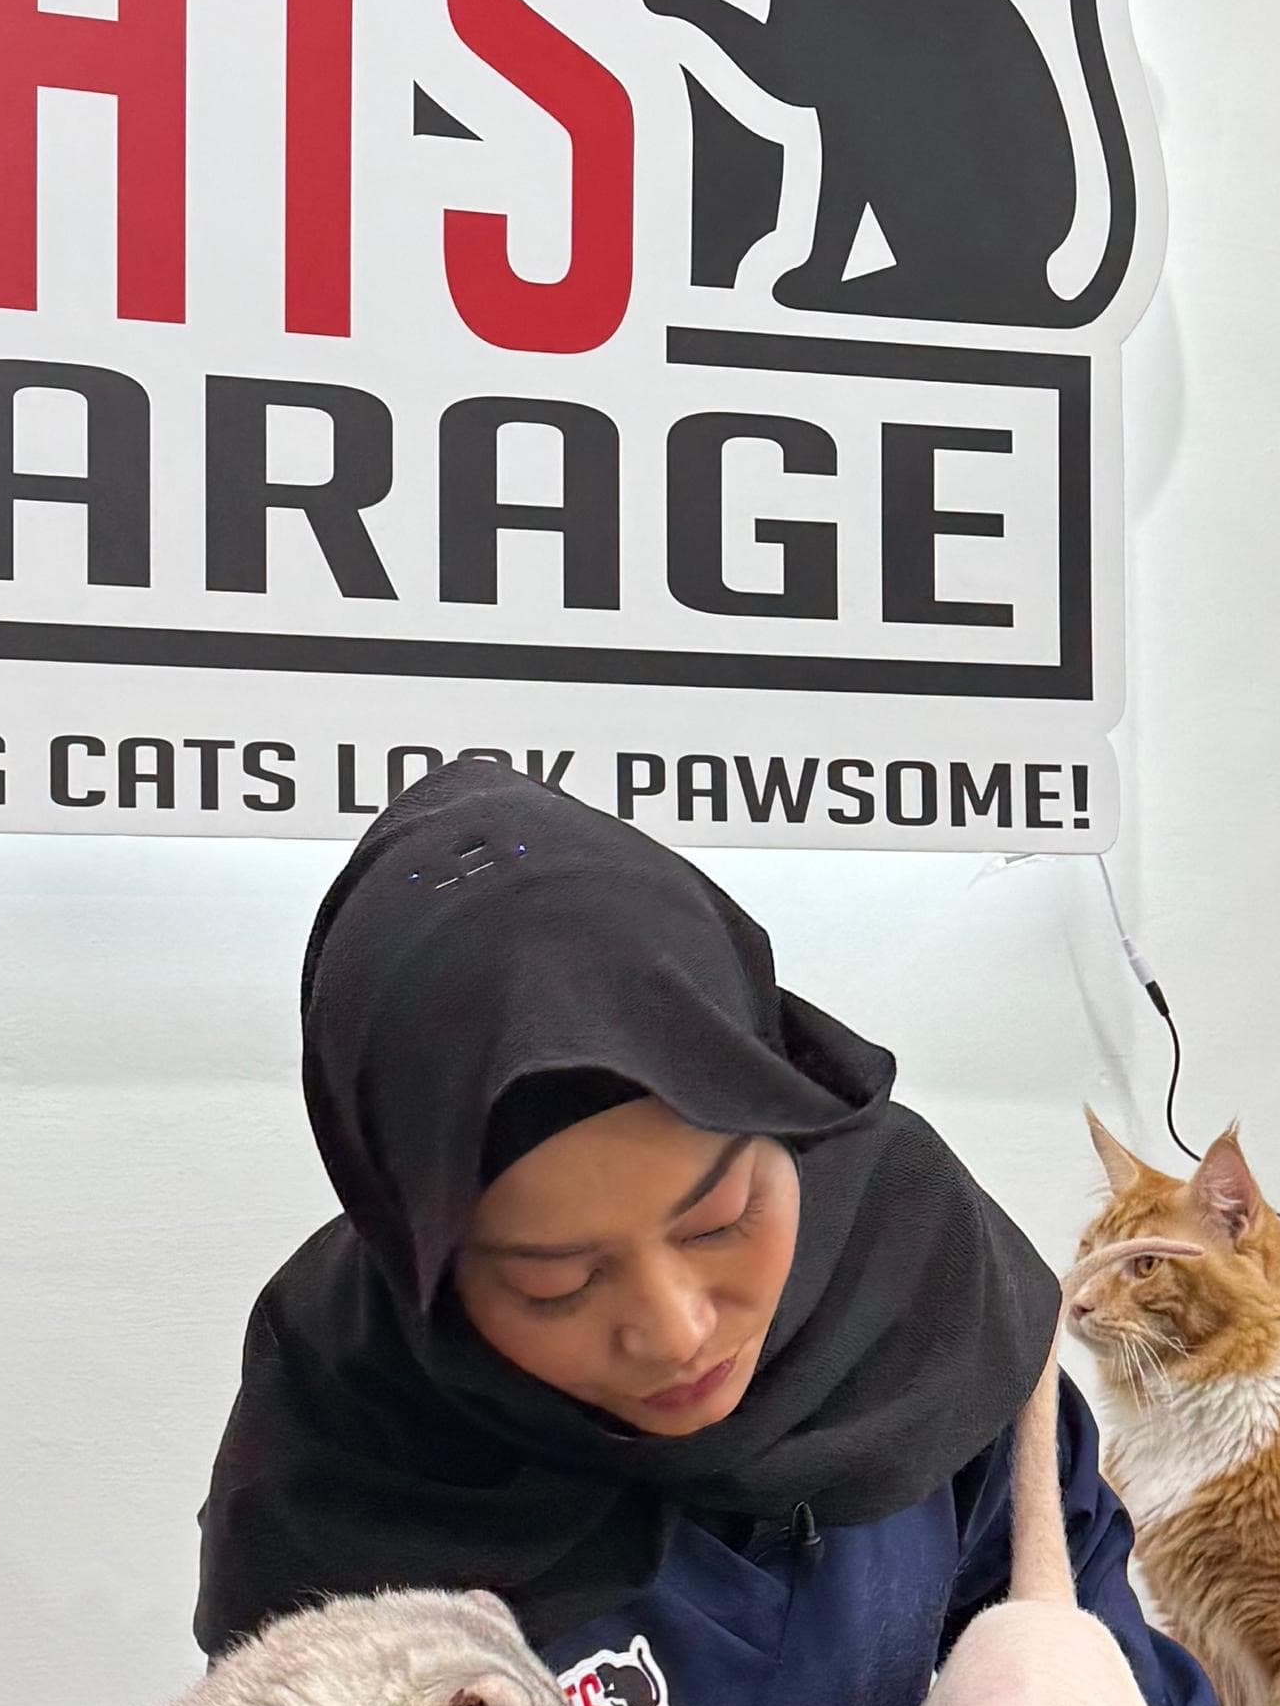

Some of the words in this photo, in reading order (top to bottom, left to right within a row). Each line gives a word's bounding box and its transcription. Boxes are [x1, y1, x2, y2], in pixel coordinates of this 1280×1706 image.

[51, 735, 296, 811] CATS
[338, 743, 576, 814] LOK
[616, 752, 1091, 829] PAWSOME!
